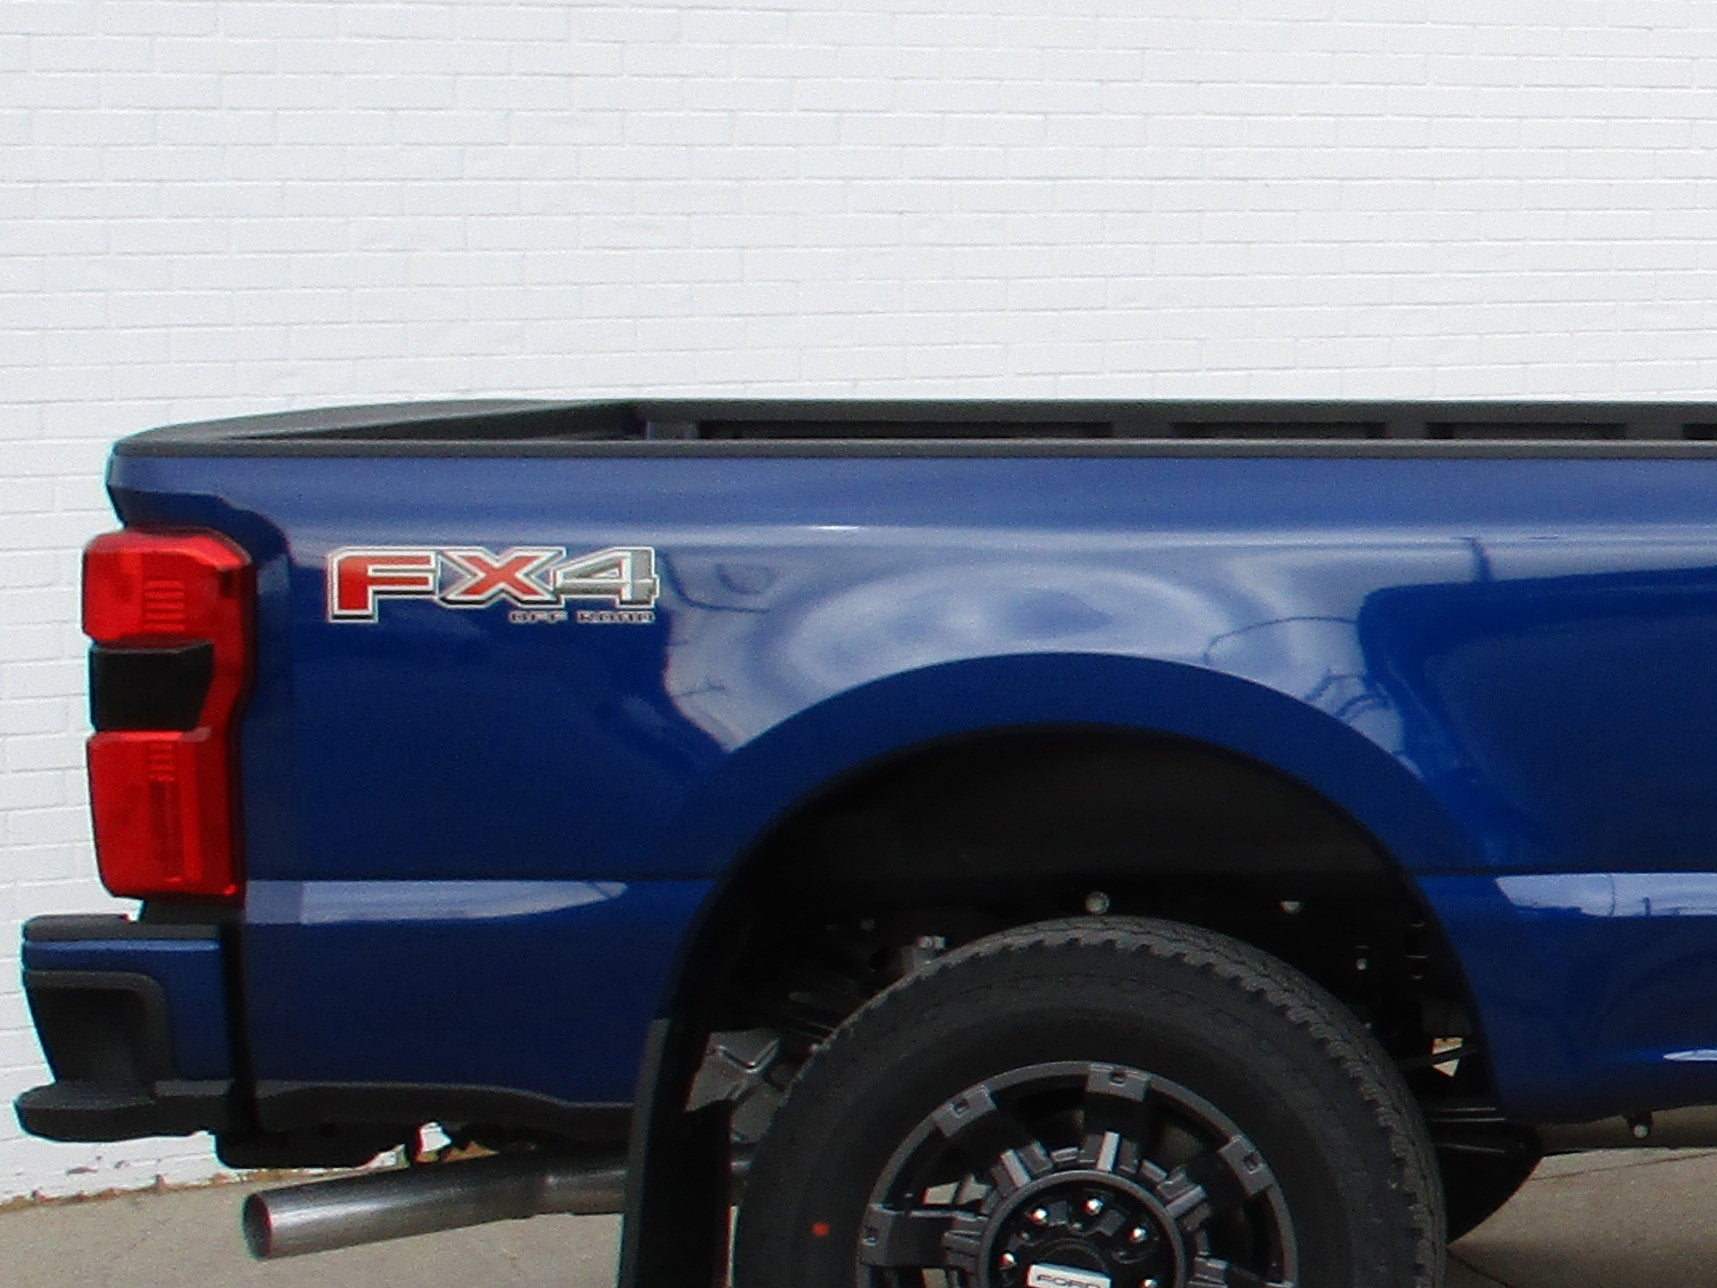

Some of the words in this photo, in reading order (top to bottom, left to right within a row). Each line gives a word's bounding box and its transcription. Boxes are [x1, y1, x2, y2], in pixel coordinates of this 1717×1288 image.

[327, 546, 660, 624] FX4
[509, 611, 568, 624] OFF
[577, 611, 656, 624] ROAD
